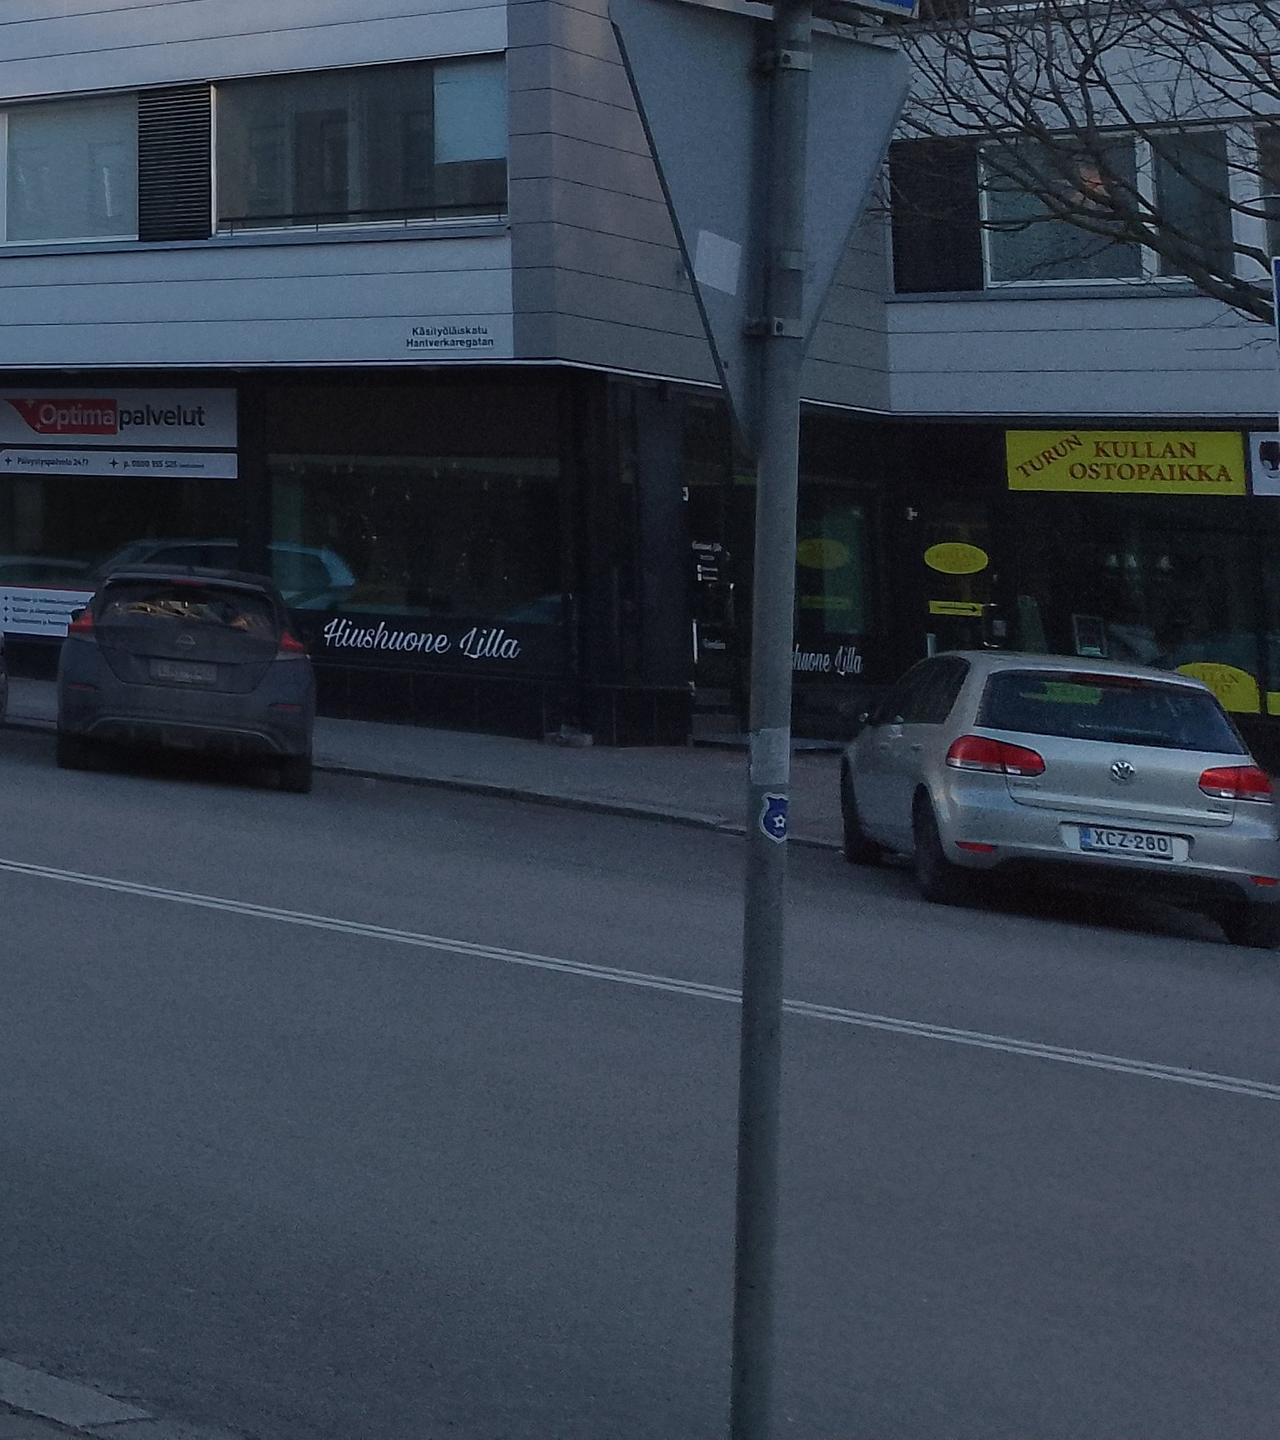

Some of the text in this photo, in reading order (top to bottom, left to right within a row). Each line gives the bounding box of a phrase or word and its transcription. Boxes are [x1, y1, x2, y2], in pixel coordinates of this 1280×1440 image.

[406, 338, 494, 348] Hantverkaregatan
[1017, 433, 1197, 479] TURUN KULLAN
[1069, 462, 1232, 482] OSTOPAIKKA
[324, 618, 522, 659] Hiushuone Lilla
[792, 643, 831, 673] huone
